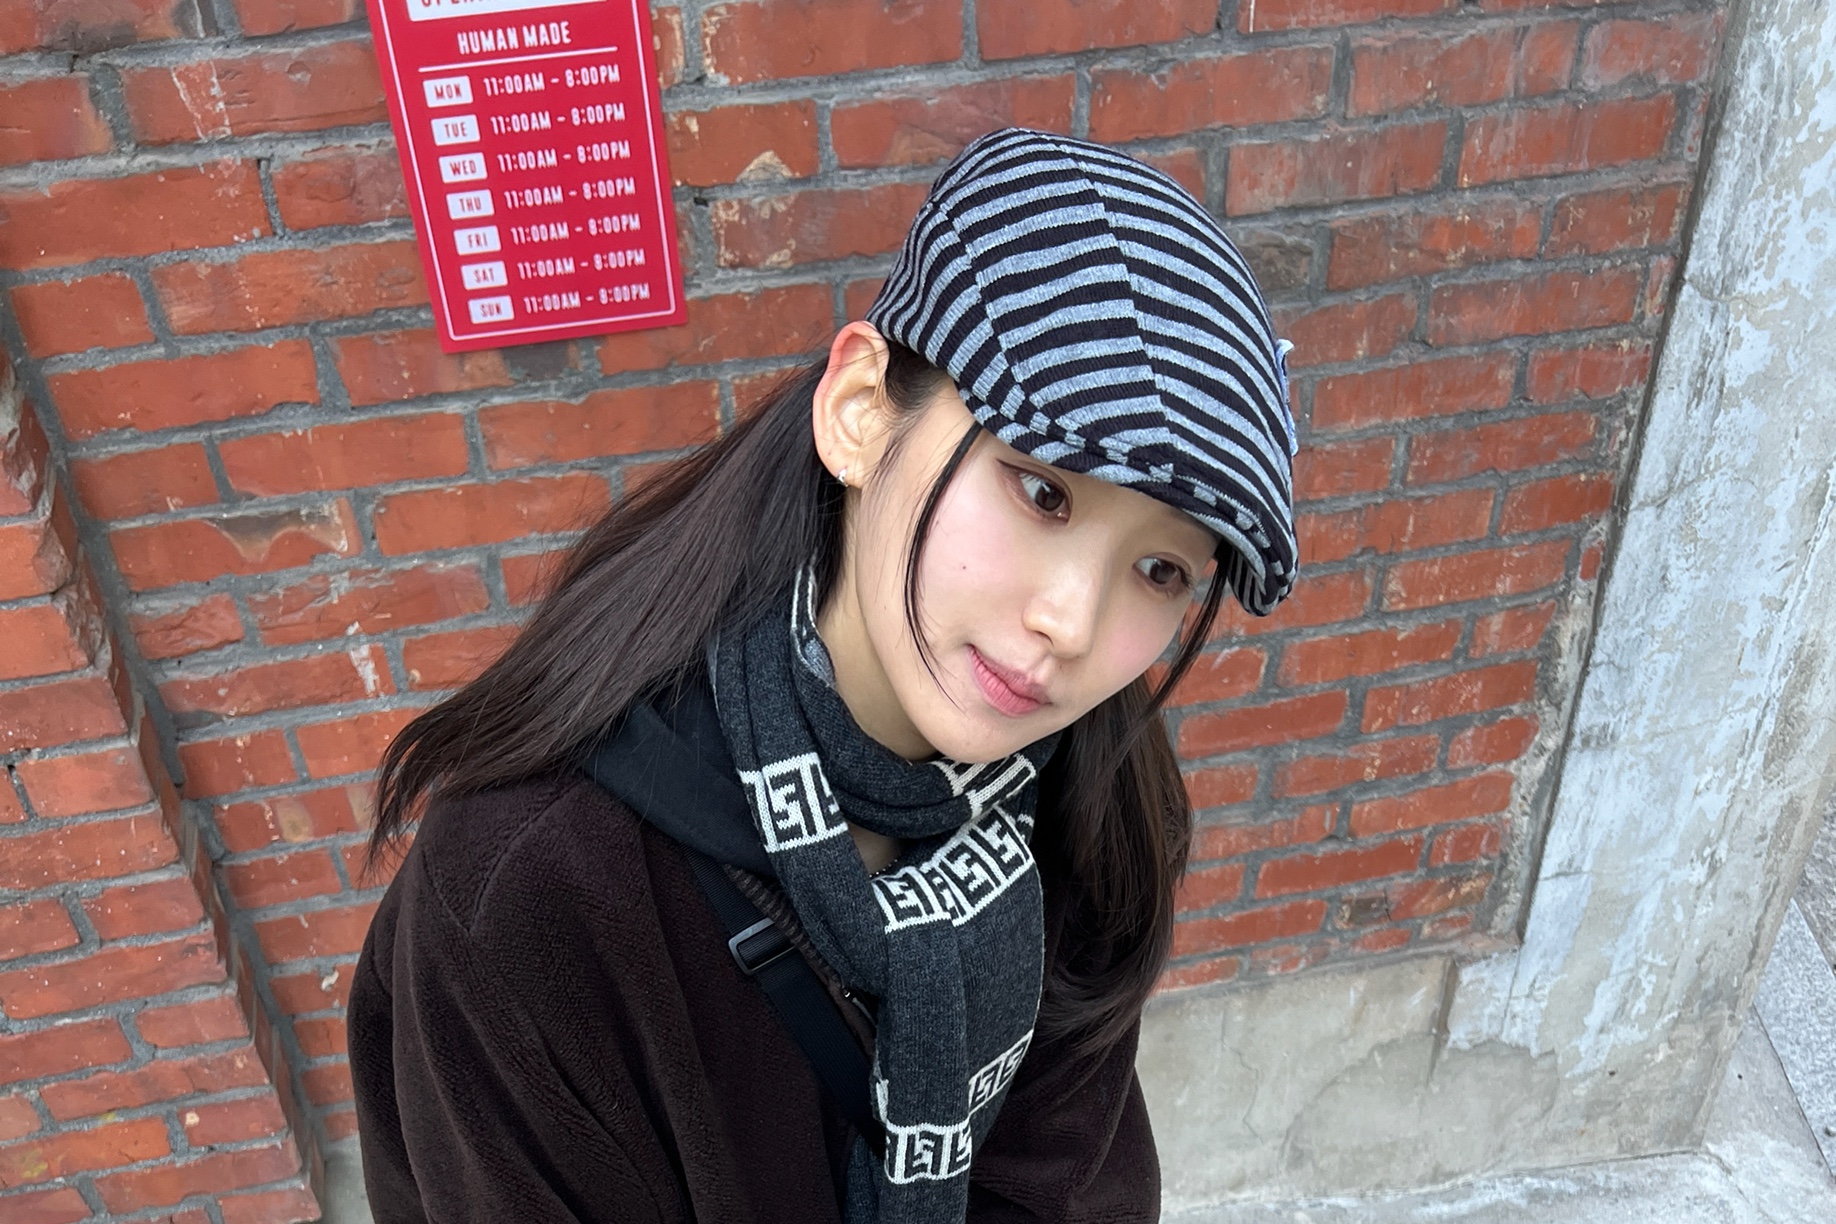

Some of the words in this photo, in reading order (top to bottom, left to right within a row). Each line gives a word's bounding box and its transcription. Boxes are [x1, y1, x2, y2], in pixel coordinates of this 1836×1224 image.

[457, 26, 519, 54] HUMAN
[522, 21, 571, 47] MADE
[434, 84, 462, 101] MON
[483, 72, 545, 96] 11:00AM
[565, 64, 620, 88] 8:00PM
[443, 121, 468, 138] TUE
[490, 111, 551, 134] 11:00AM
[571, 103, 625, 126] 8:00PM
[450, 160, 477, 176] WED
[497, 148, 557, 173] 11:00AM
[577, 140, 631, 164] 8:00PM
[459, 197, 482, 213] THU
[504, 185, 564, 209] 11:00AM
[582, 176, 636, 200] 8:00PM
[467, 234, 488, 248] FRI
[511, 221, 569, 245] 11:00AM
[588, 213, 641, 236] 8:00PM
[474, 269, 495, 284] SAT
[517, 257, 575, 280] 11:00AM
[593, 248, 645, 270] 8:00PM
[480, 303, 503, 317] SUN
[524, 291, 581, 314] 11:00AM
[599, 283, 650, 304] 8:00PM
